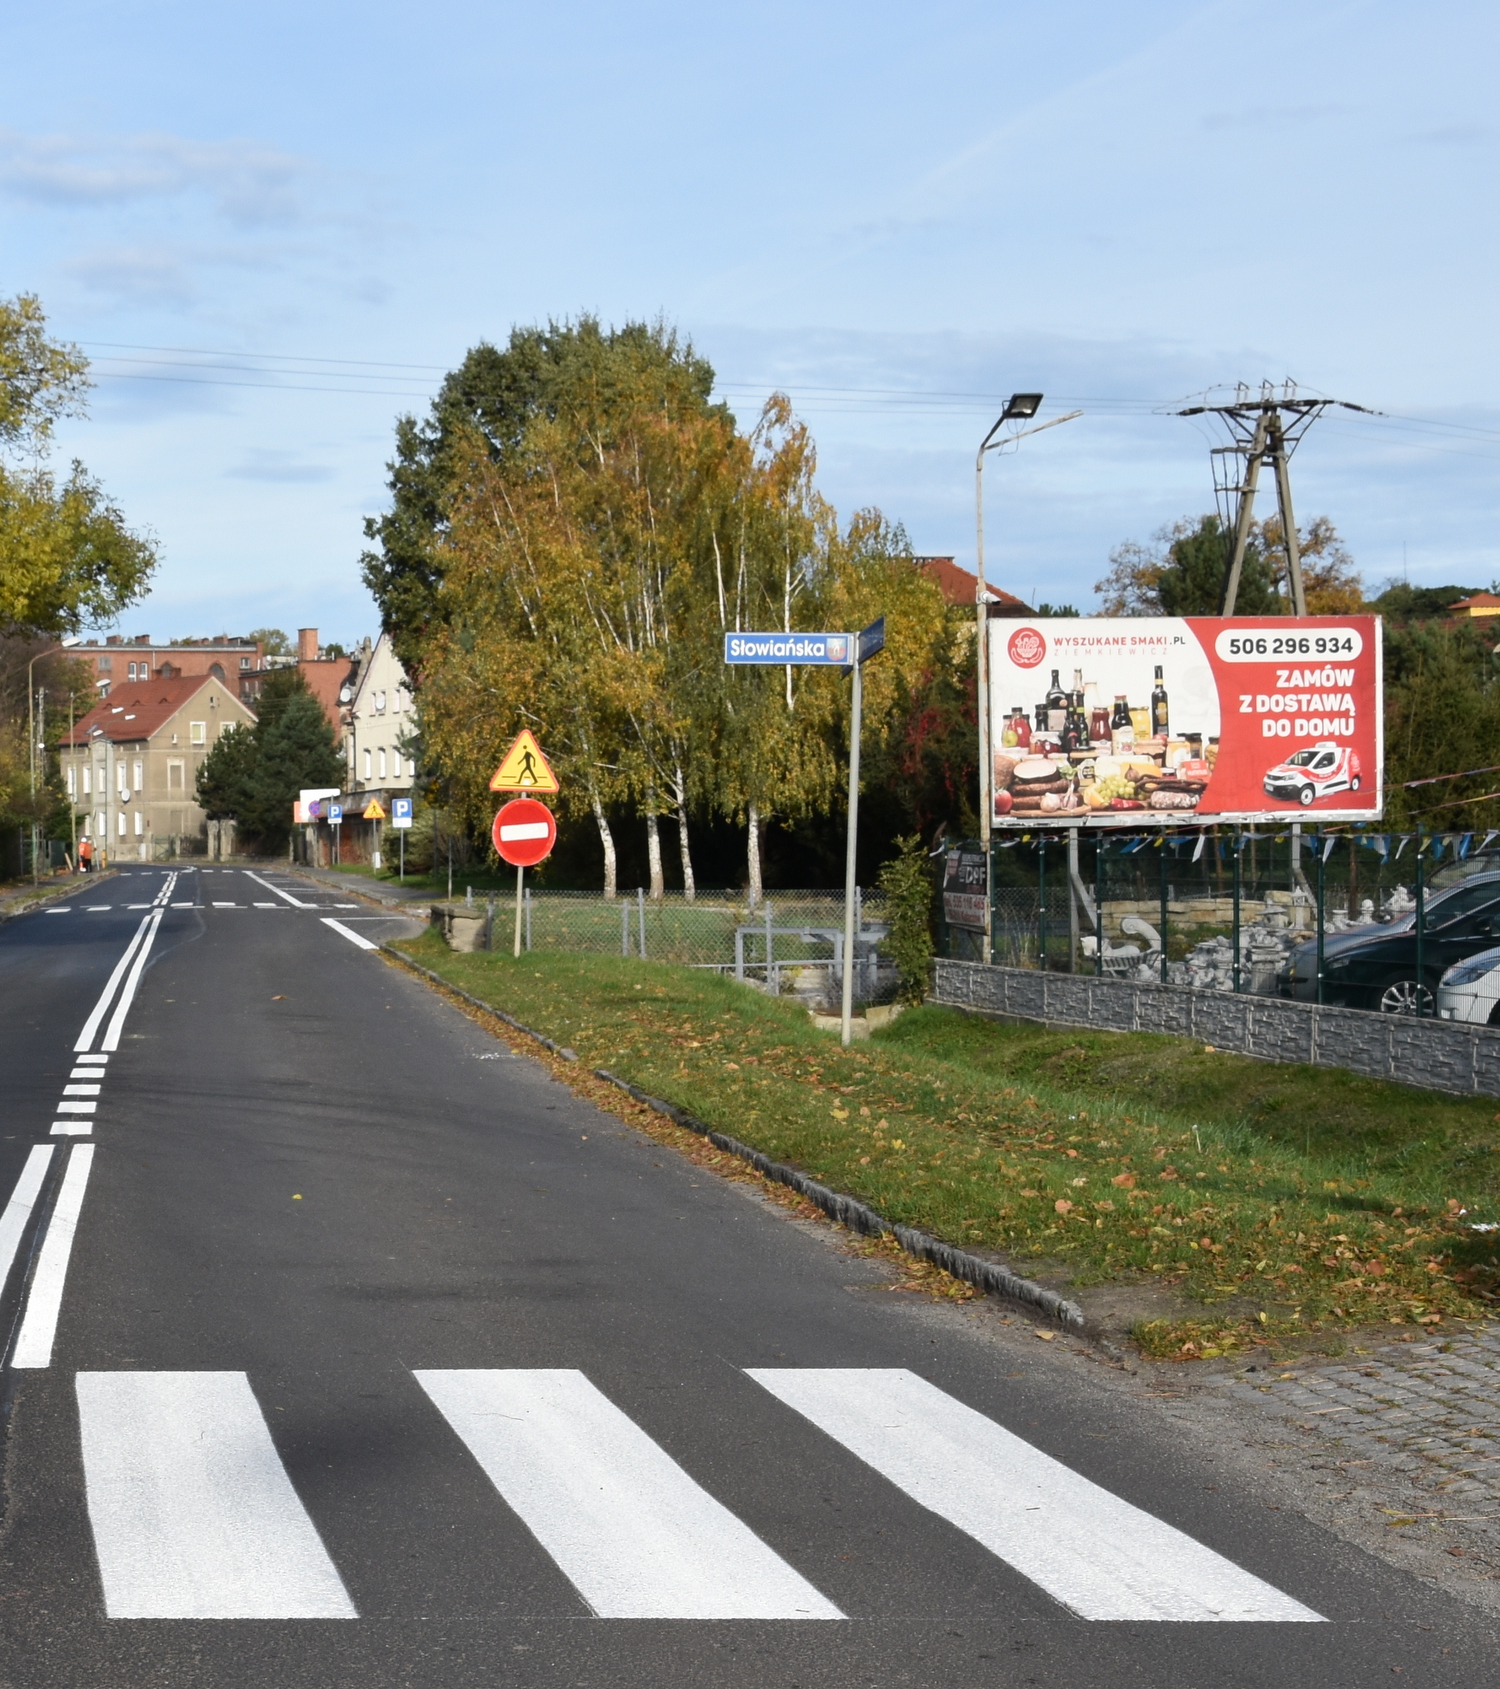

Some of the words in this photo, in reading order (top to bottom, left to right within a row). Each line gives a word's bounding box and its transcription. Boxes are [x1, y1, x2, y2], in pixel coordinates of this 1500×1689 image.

[730, 638, 825, 657] Słowiańska
[1053, 636, 1127, 646] WYSZUKANE
[1229, 638, 1267, 655] 506
[1272, 638, 1310, 654] 296
[1315, 637, 1353, 653] 934
[1054, 647, 1167, 656] ZIEMKIEWICZ
[1276, 664, 1355, 688] ZAMÓW
[1239, 695, 1253, 713] Z
[1256, 693, 1356, 717] DOSTAWĄ
[1262, 719, 1291, 737] DO
[1294, 717, 1355, 737] DOMU
[396, 801, 409, 817] P
